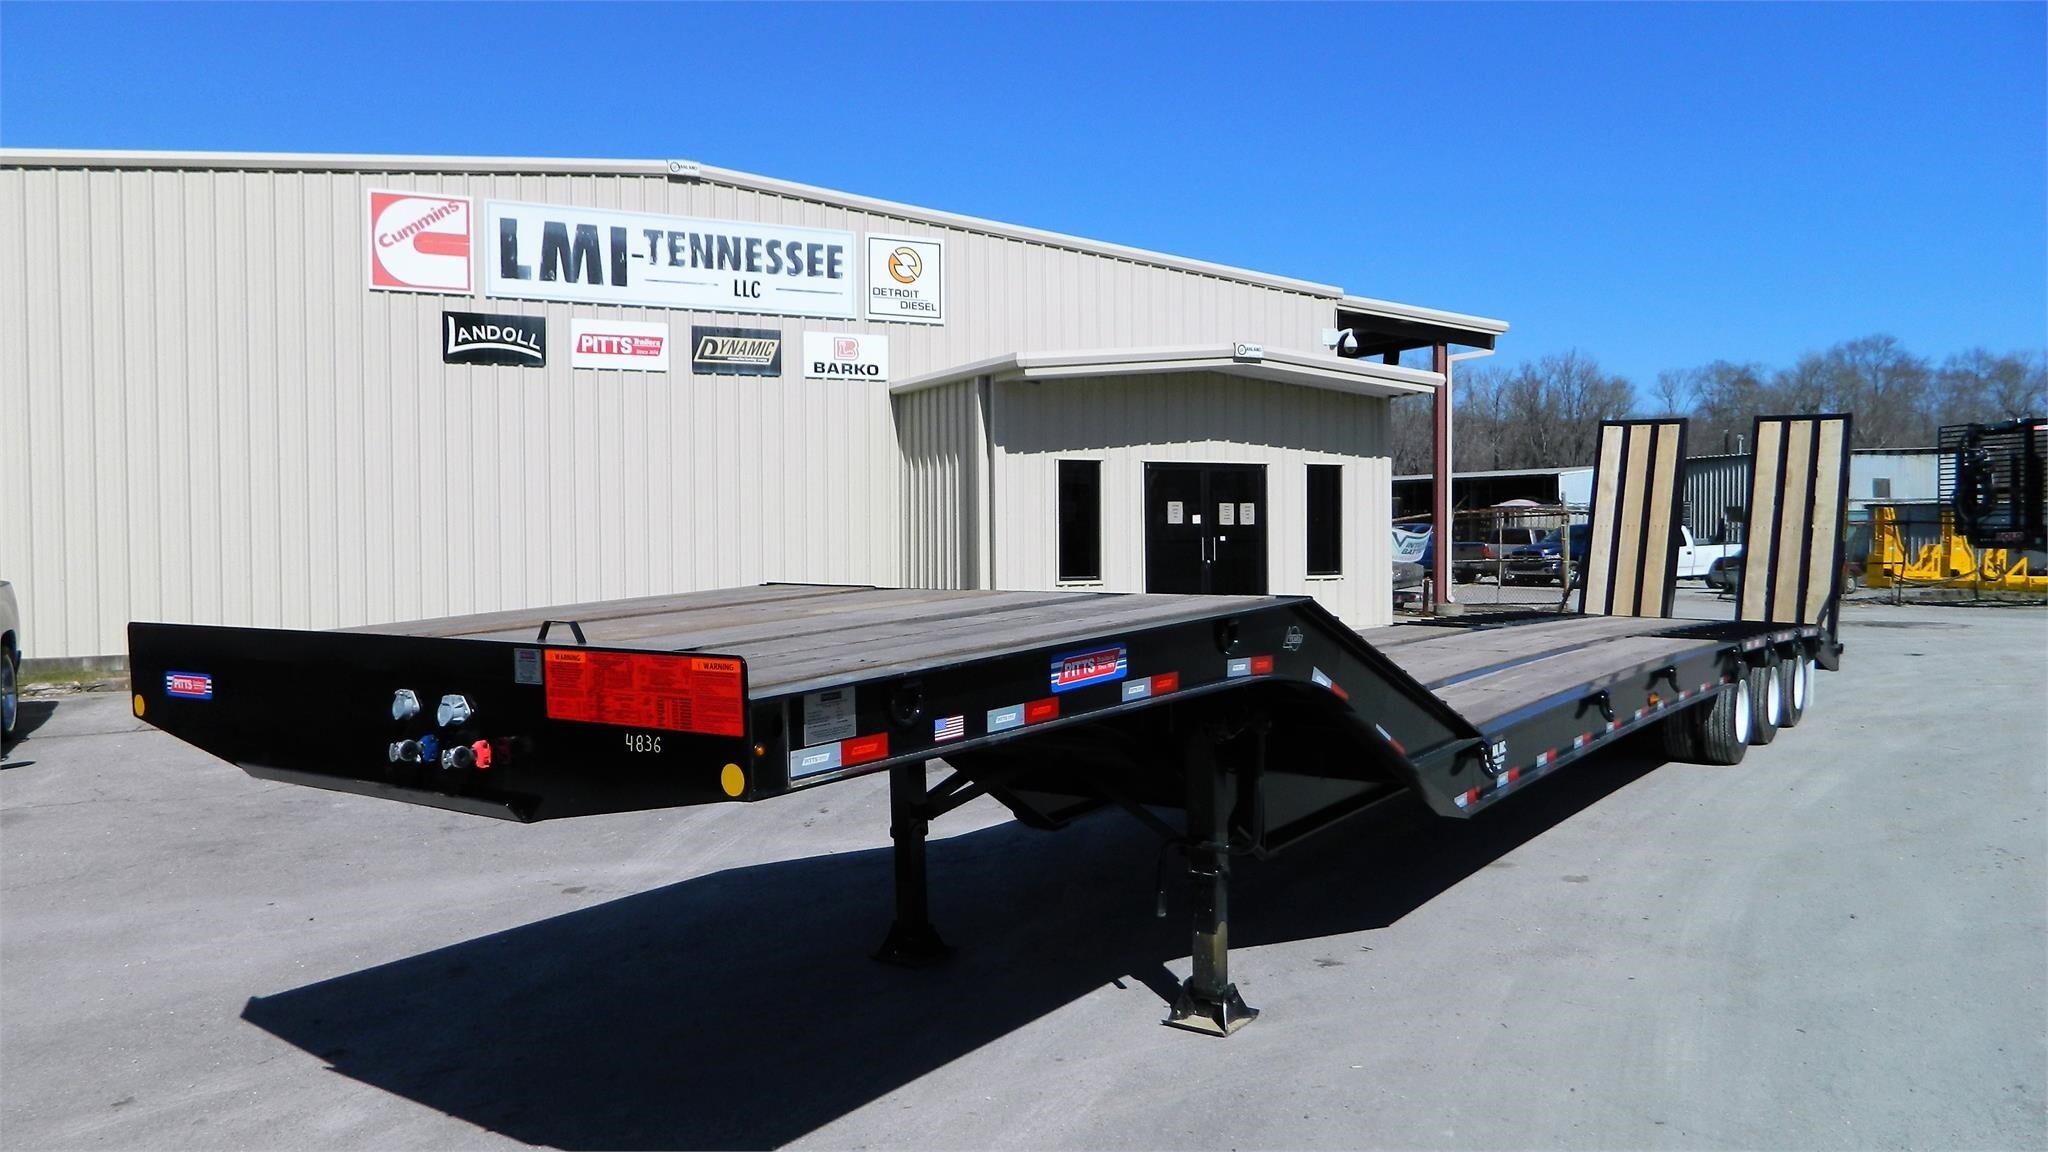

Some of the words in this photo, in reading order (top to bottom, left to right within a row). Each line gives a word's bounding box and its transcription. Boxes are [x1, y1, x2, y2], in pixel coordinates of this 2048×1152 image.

[378, 200, 460, 248] Cummins
[733, 279, 761, 299] LLC
[872, 287, 919, 299] DETROIT
[900, 300, 937, 312] DIESEL
[447, 316, 543, 358] LANDOLL
[581, 335, 633, 354] PITTS
[698, 338, 775, 359] DYNAMIC
[813, 361, 879, 376] BARKO
[703, 662, 735, 671] WARNING
[1065, 658, 1095, 678] PITTS
[625, 733, 661, 753] 4836
